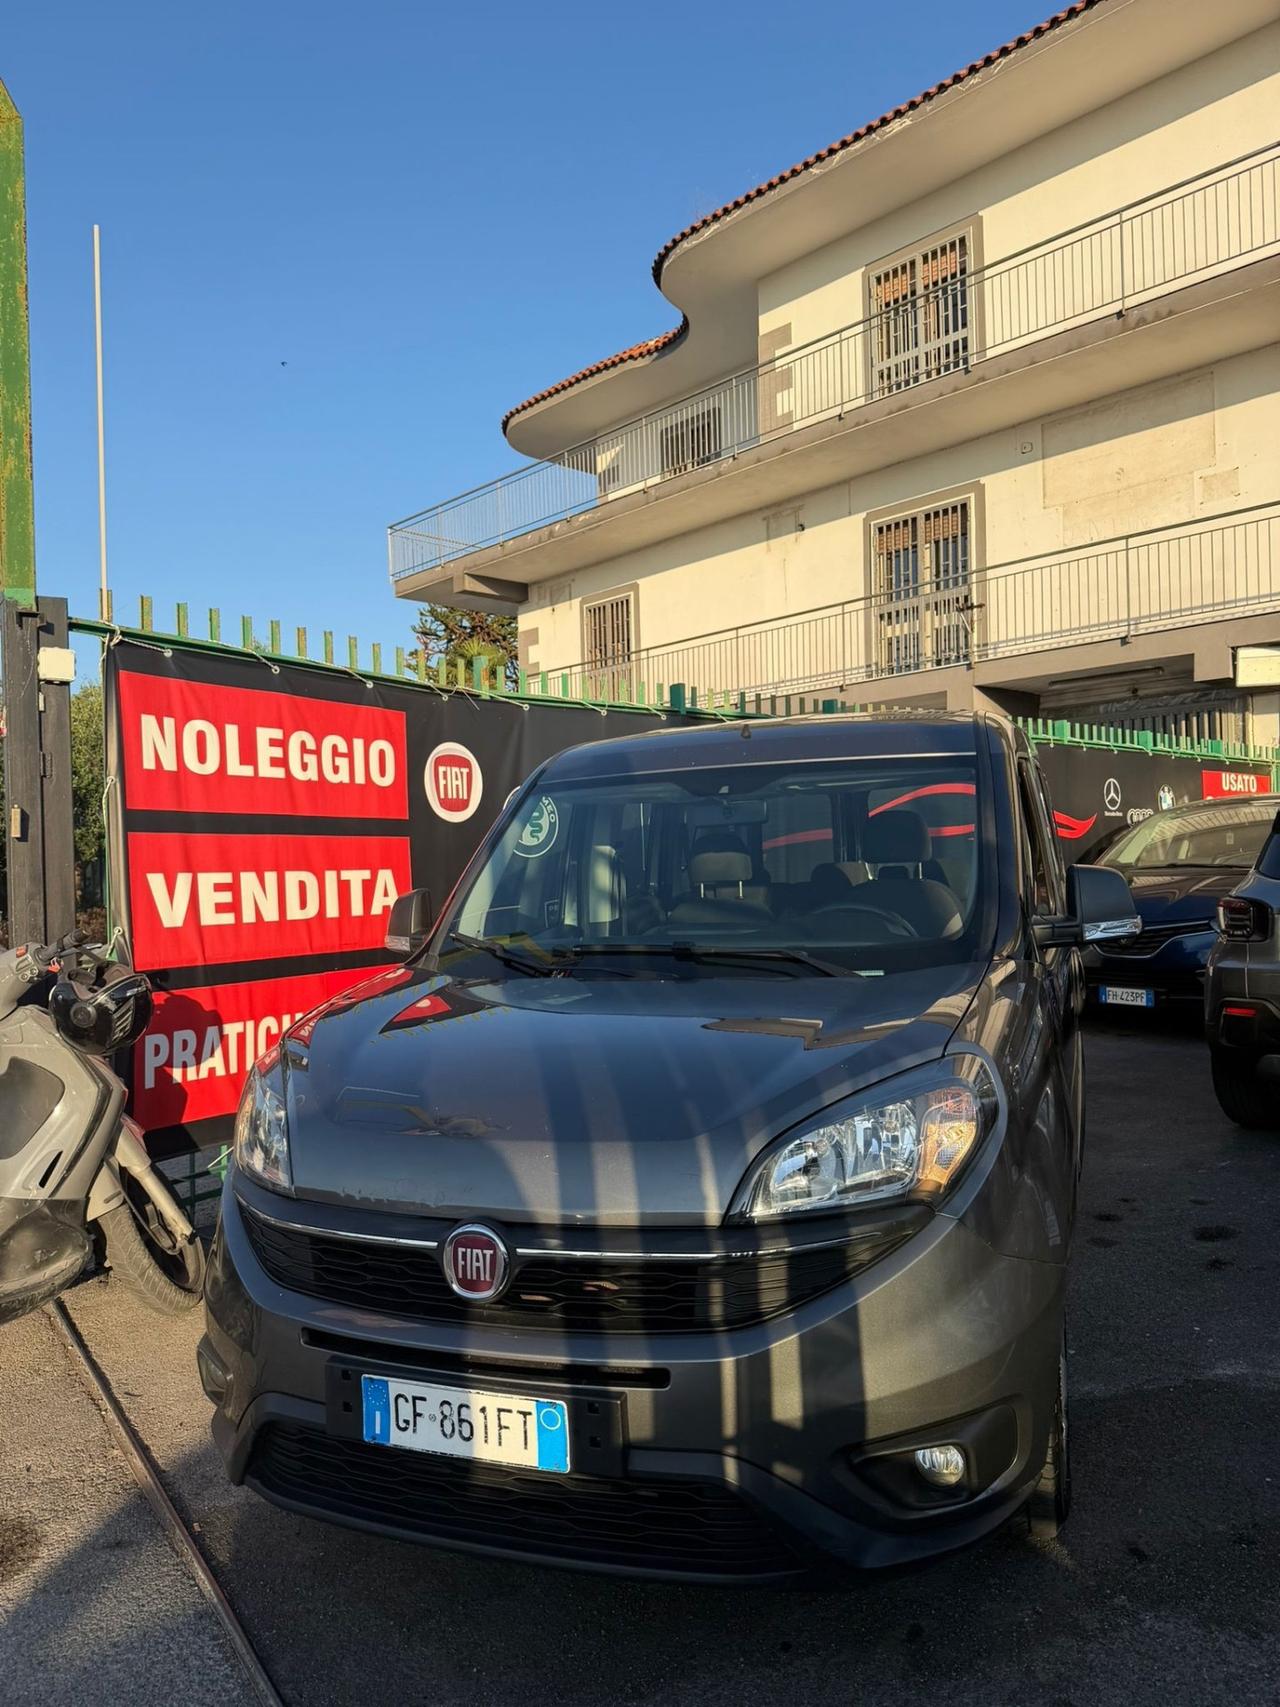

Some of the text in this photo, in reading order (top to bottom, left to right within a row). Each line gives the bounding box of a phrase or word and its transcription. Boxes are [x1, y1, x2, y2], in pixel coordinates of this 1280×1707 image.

[140, 714, 396, 787] NOLEGGIO
[438, 765, 470, 800] FIAT
[1221, 772, 1258, 793] USATO
[146, 868, 398, 928] VENDITA
[457, 1247, 495, 1282] FIAT
